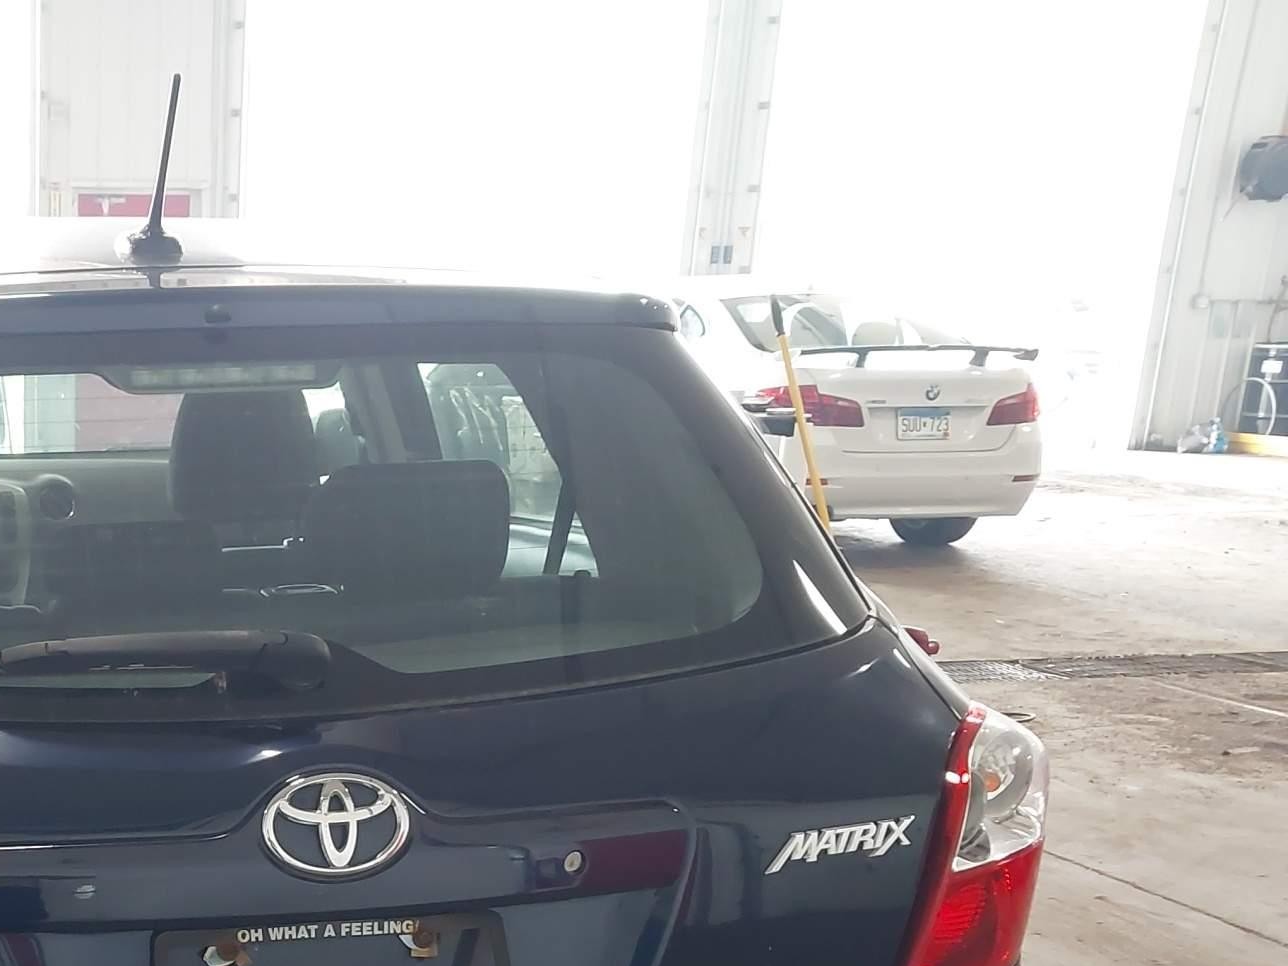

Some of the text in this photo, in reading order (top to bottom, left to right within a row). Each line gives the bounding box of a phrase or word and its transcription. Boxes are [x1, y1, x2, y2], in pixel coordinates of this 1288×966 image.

[764, 815, 916, 875] MATRIX
[237, 929, 263, 943] OH
[268, 925, 319, 941] WHAT
[323, 924, 336, 937] A
